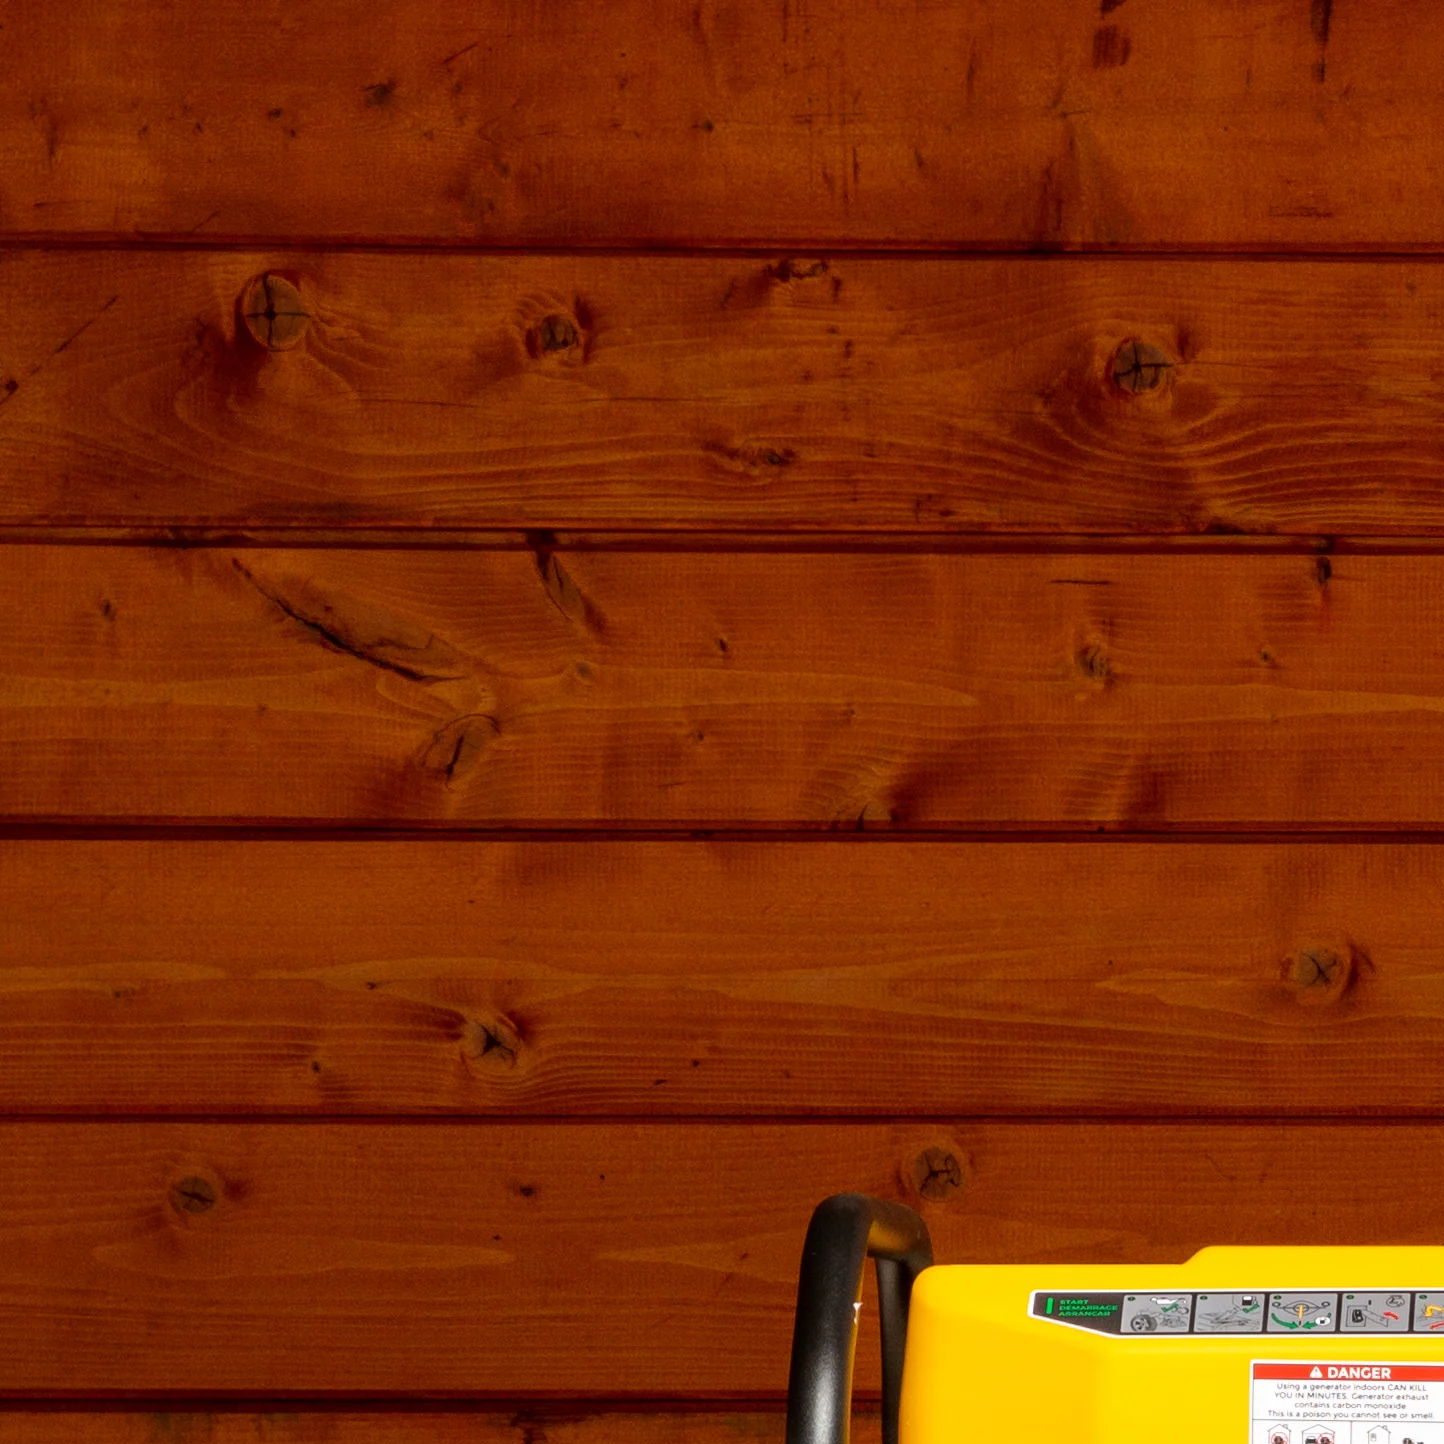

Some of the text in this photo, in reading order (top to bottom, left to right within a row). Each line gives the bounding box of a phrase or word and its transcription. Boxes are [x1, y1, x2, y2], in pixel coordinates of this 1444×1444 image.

[1327, 1367, 1391, 1379] DANGER
[1277, 1383, 1300, 1393] Using
[1309, 1383, 1350, 1393] generator
[1353, 1383, 1384, 1392] indoors
[1387, 1383, 1406, 1392] CAN
[1409, 1384, 1426, 1392] KILL
[1275, 1391, 1292, 1399] YOU
[1351, 1392, 1393, 1400] Generator
[1396, 1393, 1428, 1401] exhaust
[1294, 1401, 1329, 1409] contains
[1332, 1401, 1361, 1409] carbon
[1268, 1409, 1284, 1418] This
[1302, 1411, 1330, 1420] poison
[1333, 1412, 1348, 1421] you
[1351, 1411, 1379, 1419] cannot
